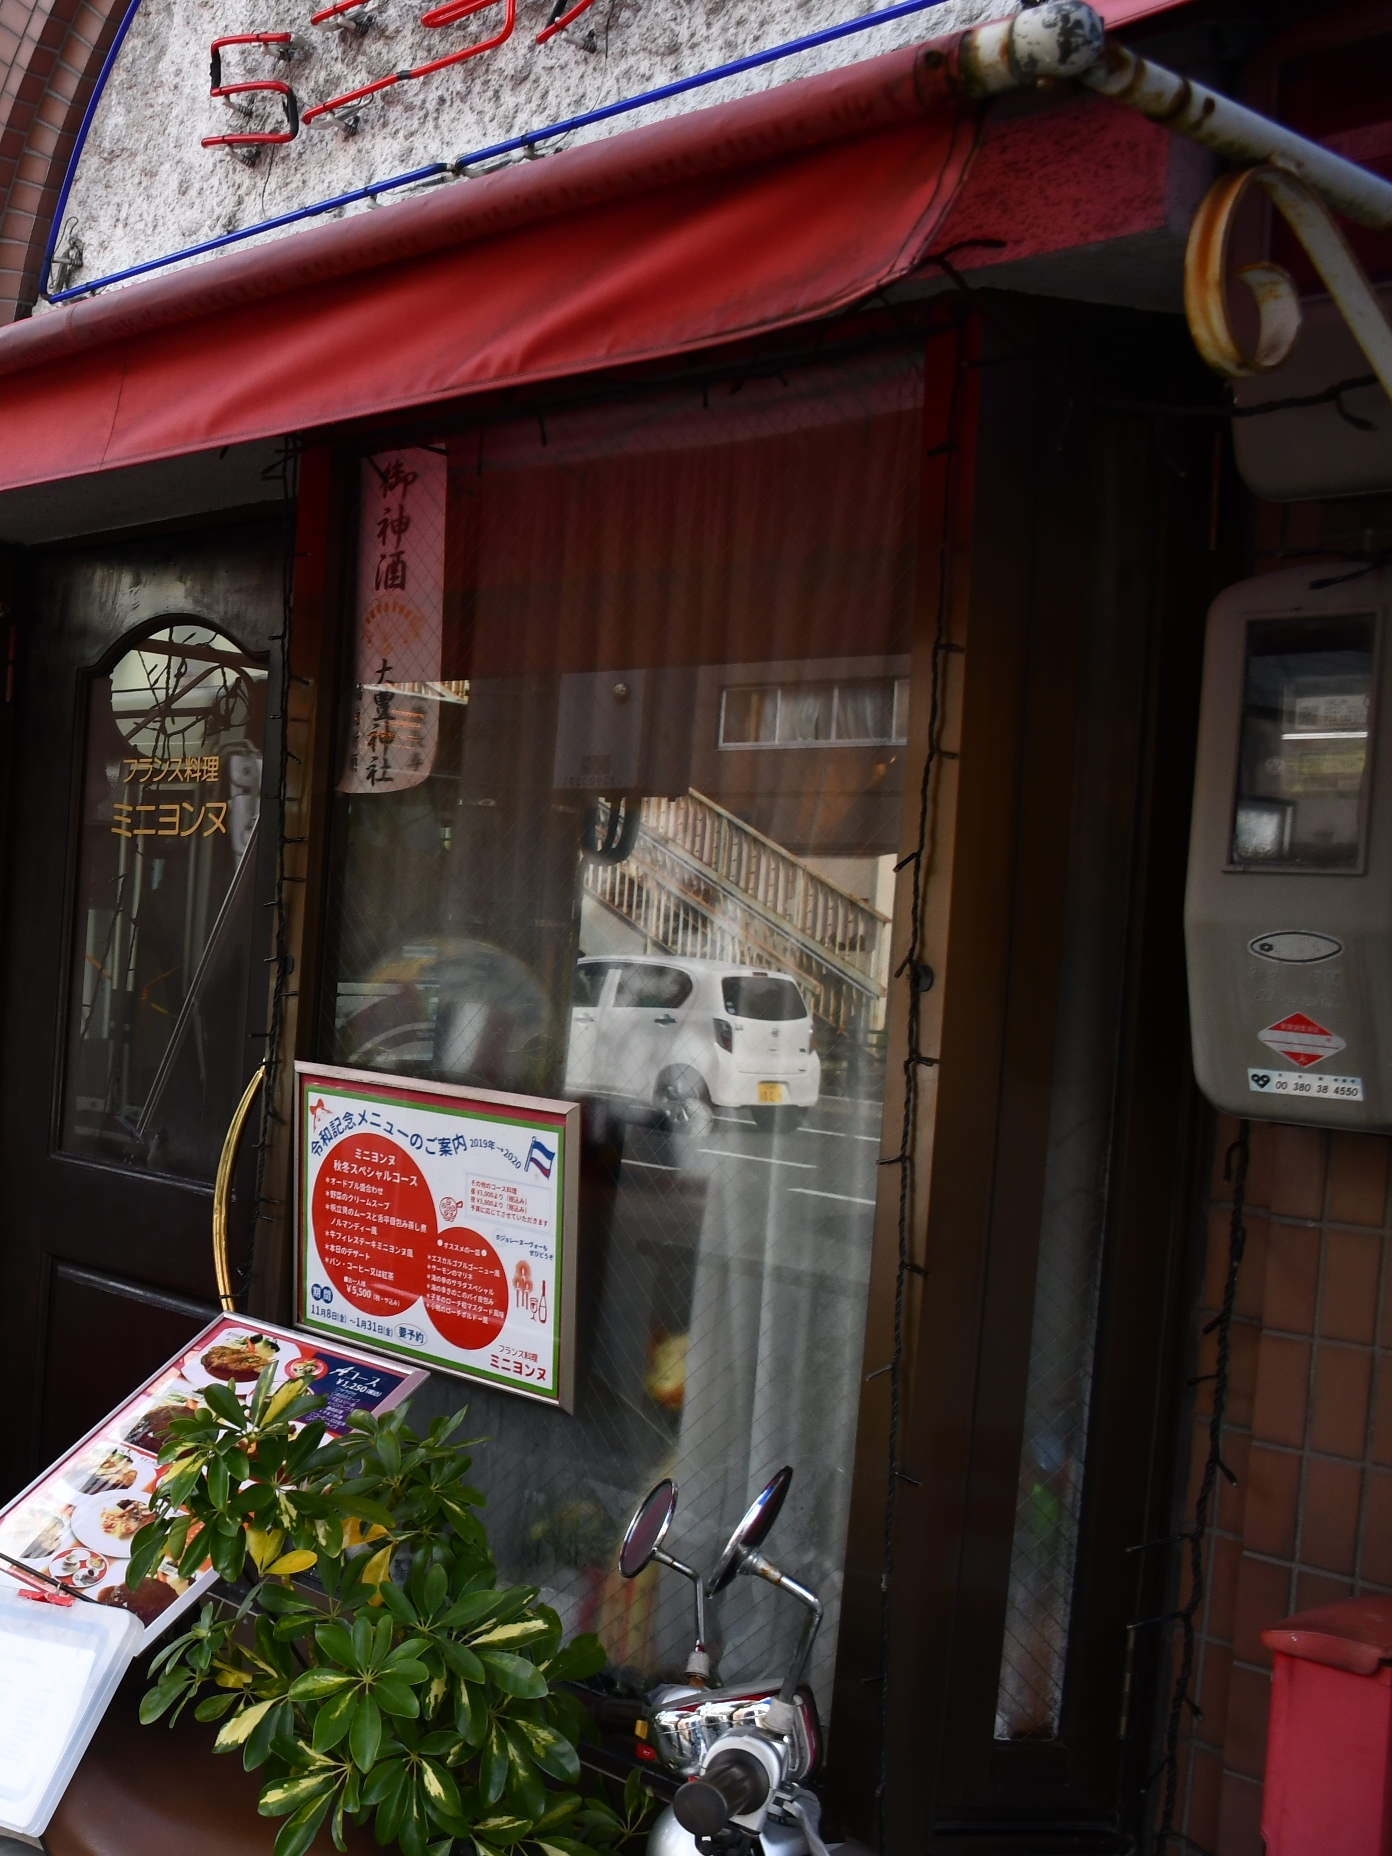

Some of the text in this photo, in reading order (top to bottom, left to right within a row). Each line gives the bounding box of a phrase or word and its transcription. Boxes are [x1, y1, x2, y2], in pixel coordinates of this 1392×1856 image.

[122, 754, 221, 784] フランス料理
[110, 802, 228, 838] ミニヨンヌ
[311, 1109, 467, 1157] 令和記念メニューのご案内
[469, 1138, 496, 1150] 2019年
[353, 1147, 396, 1166] ミニヨンヌ
[333, 1158, 418, 1187] 秋冬スペシャルコース
[398, 1325, 423, 1343] 要予約
[489, 1353, 546, 1382] ミニヨンヌ
